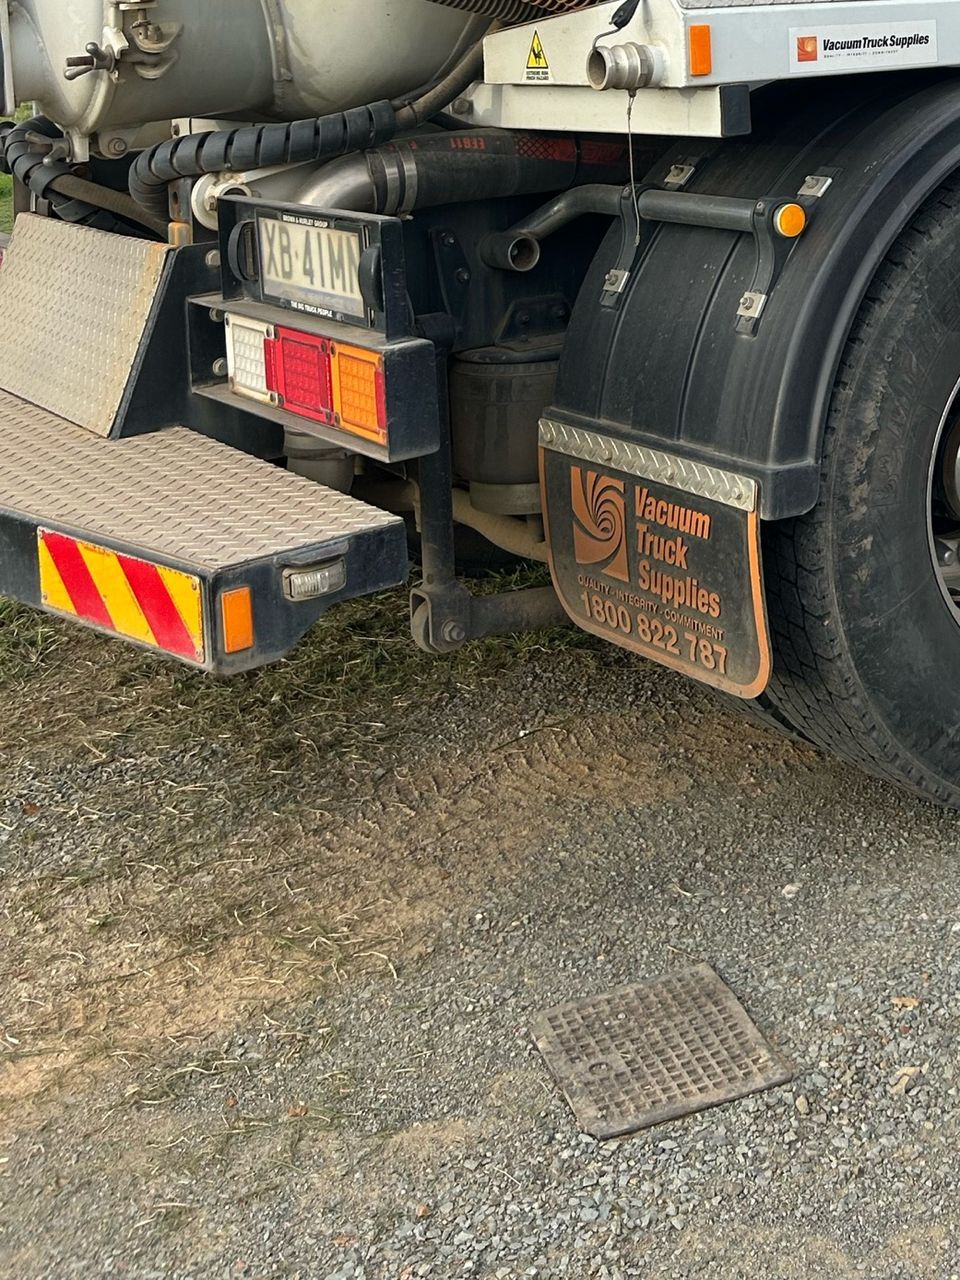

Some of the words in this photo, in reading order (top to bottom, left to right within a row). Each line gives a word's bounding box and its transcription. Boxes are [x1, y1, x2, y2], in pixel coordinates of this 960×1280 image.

[635, 485, 711, 540] Vacuum
[636, 523, 689, 570] Truck
[577, 574, 610, 596] QUALITY
[616, 591, 659, 614] INTEGRITY
[664, 608, 725, 641] COMMITMENT
[638, 560, 721, 618] Supplies
[580, 591, 632, 634] 1800
[637, 613, 681, 655] 822
[684, 631, 728, 674] 787
